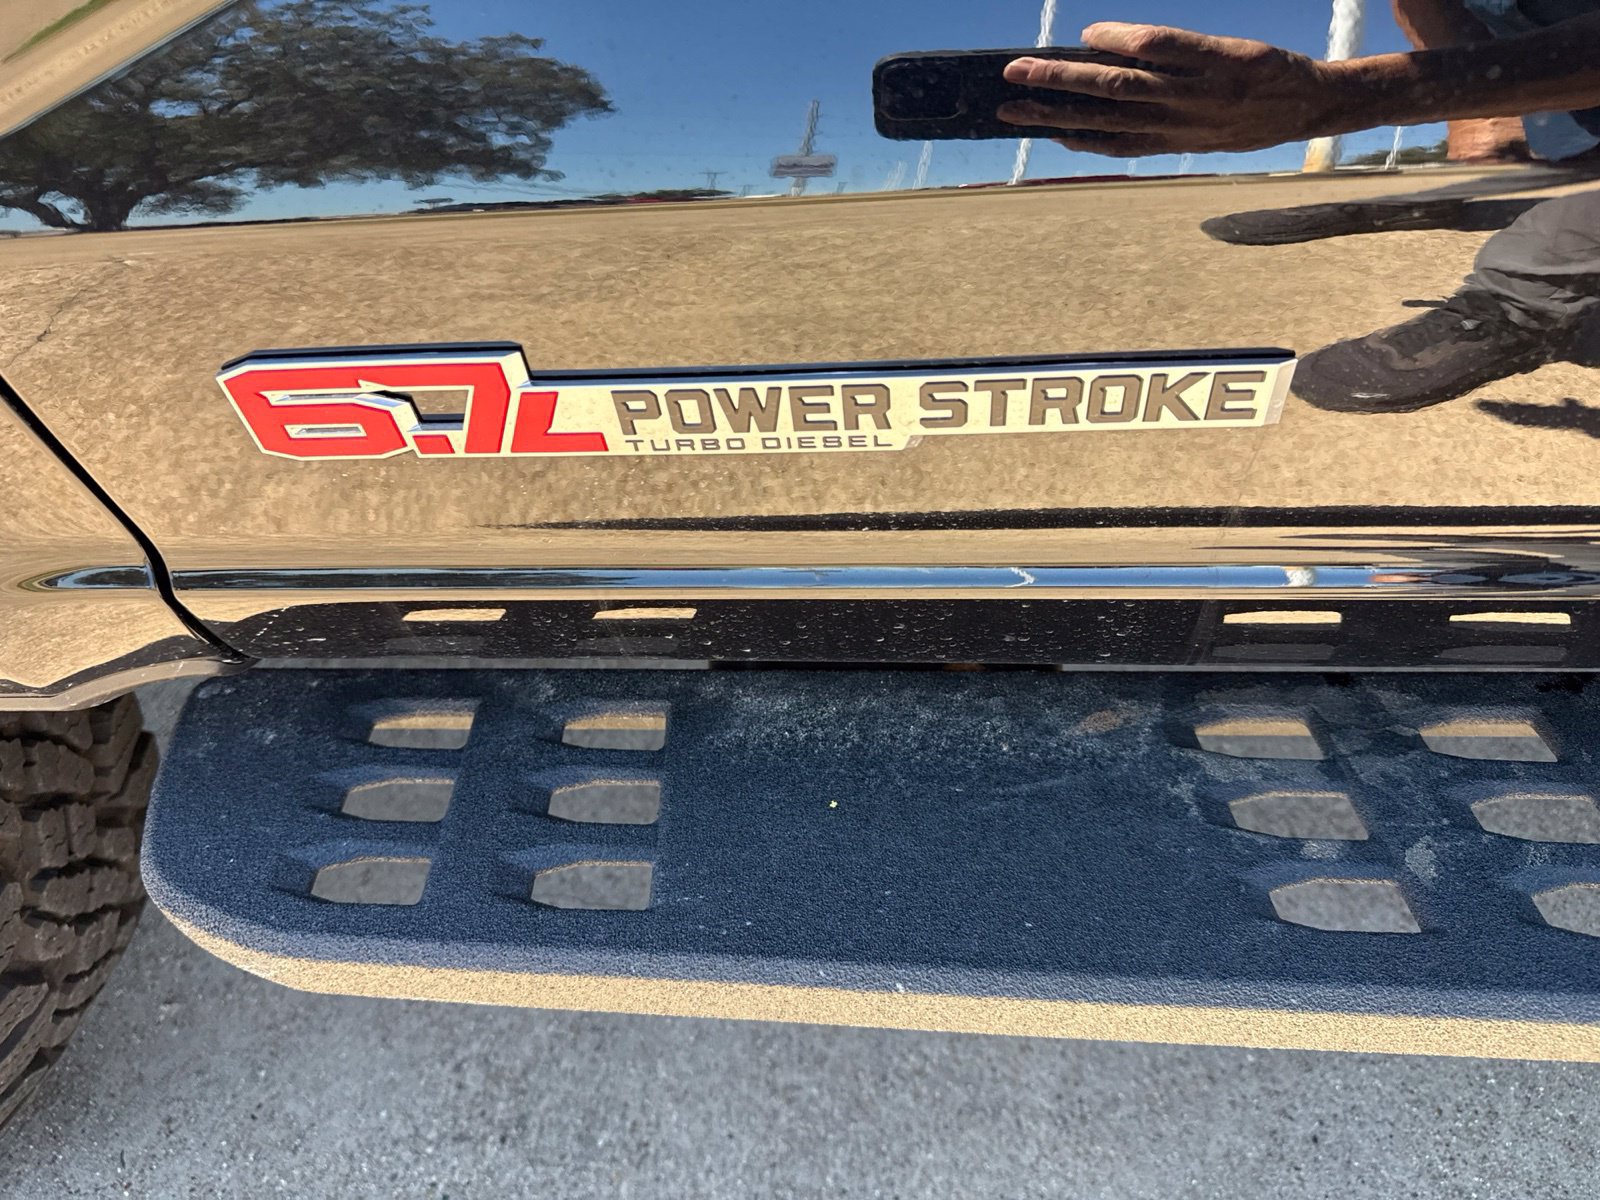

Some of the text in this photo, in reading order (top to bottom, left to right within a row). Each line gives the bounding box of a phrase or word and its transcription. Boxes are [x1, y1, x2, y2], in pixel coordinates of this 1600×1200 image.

[223, 361, 1267, 457] 6.7L POWER STROKE
[625, 435, 893, 451] TURBO DIESEL
